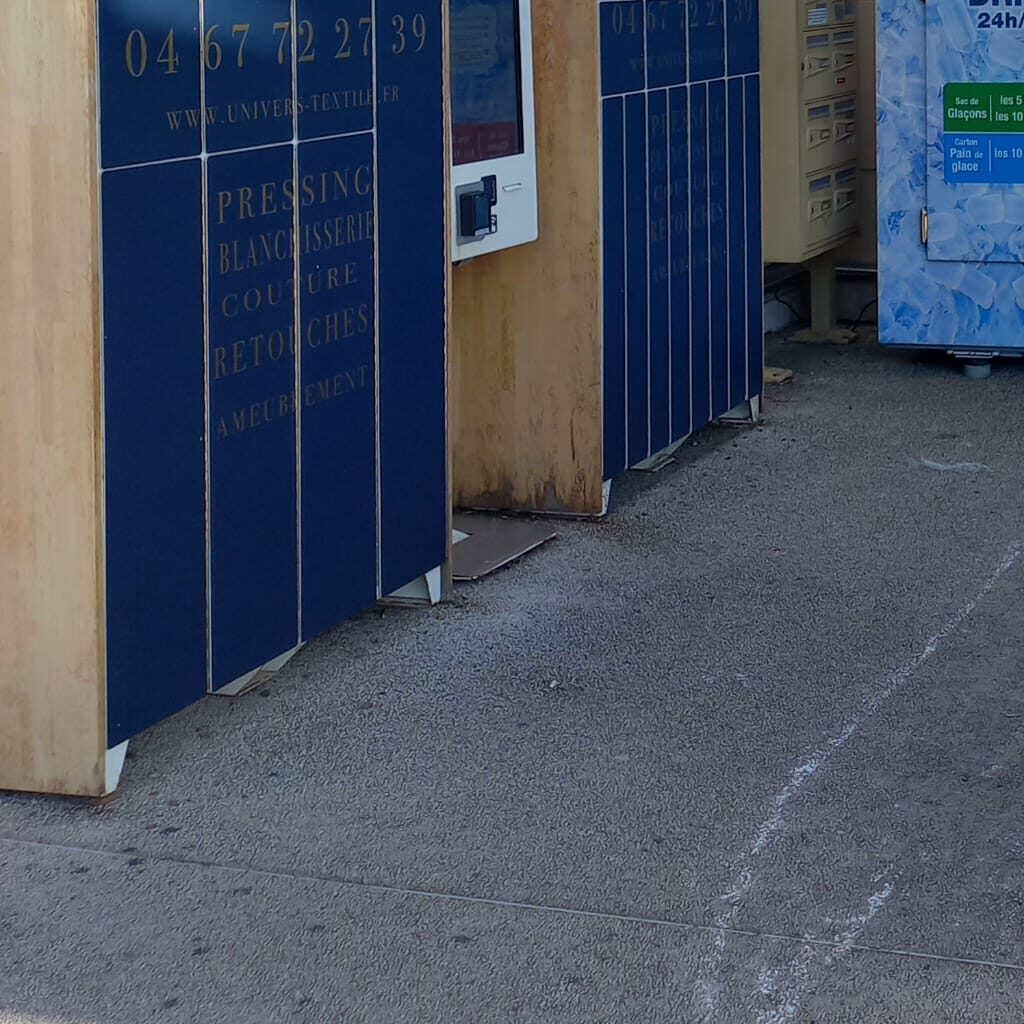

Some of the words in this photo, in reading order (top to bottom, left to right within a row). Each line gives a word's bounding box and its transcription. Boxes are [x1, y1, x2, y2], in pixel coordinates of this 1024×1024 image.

[125, 28, 179, 77] 04
[203, 24, 250, 70] 67
[272, 19, 315, 64] 72
[335, 16, 373, 59] 27
[392, 13, 427, 54] 39
[955, 97, 969, 105] Sac
[970, 97, 979, 105] de
[1000, 95, 1014, 105] les
[1016, 95, 1022, 105] 5
[166, 84, 400, 130] WWW.UNIVERS-TEXTILE.FR
[947, 108, 988, 121] Glaçons
[995, 112, 1009, 122] les
[1012, 112, 1024, 122] 10
[954, 138, 978, 146] Carton
[950, 148, 972, 159] Pain
[994, 148, 1009, 158] les
[1011, 148, 1023, 158] 10
[951, 161, 979, 173] glace
[217, 165, 371, 225] PRESSING
